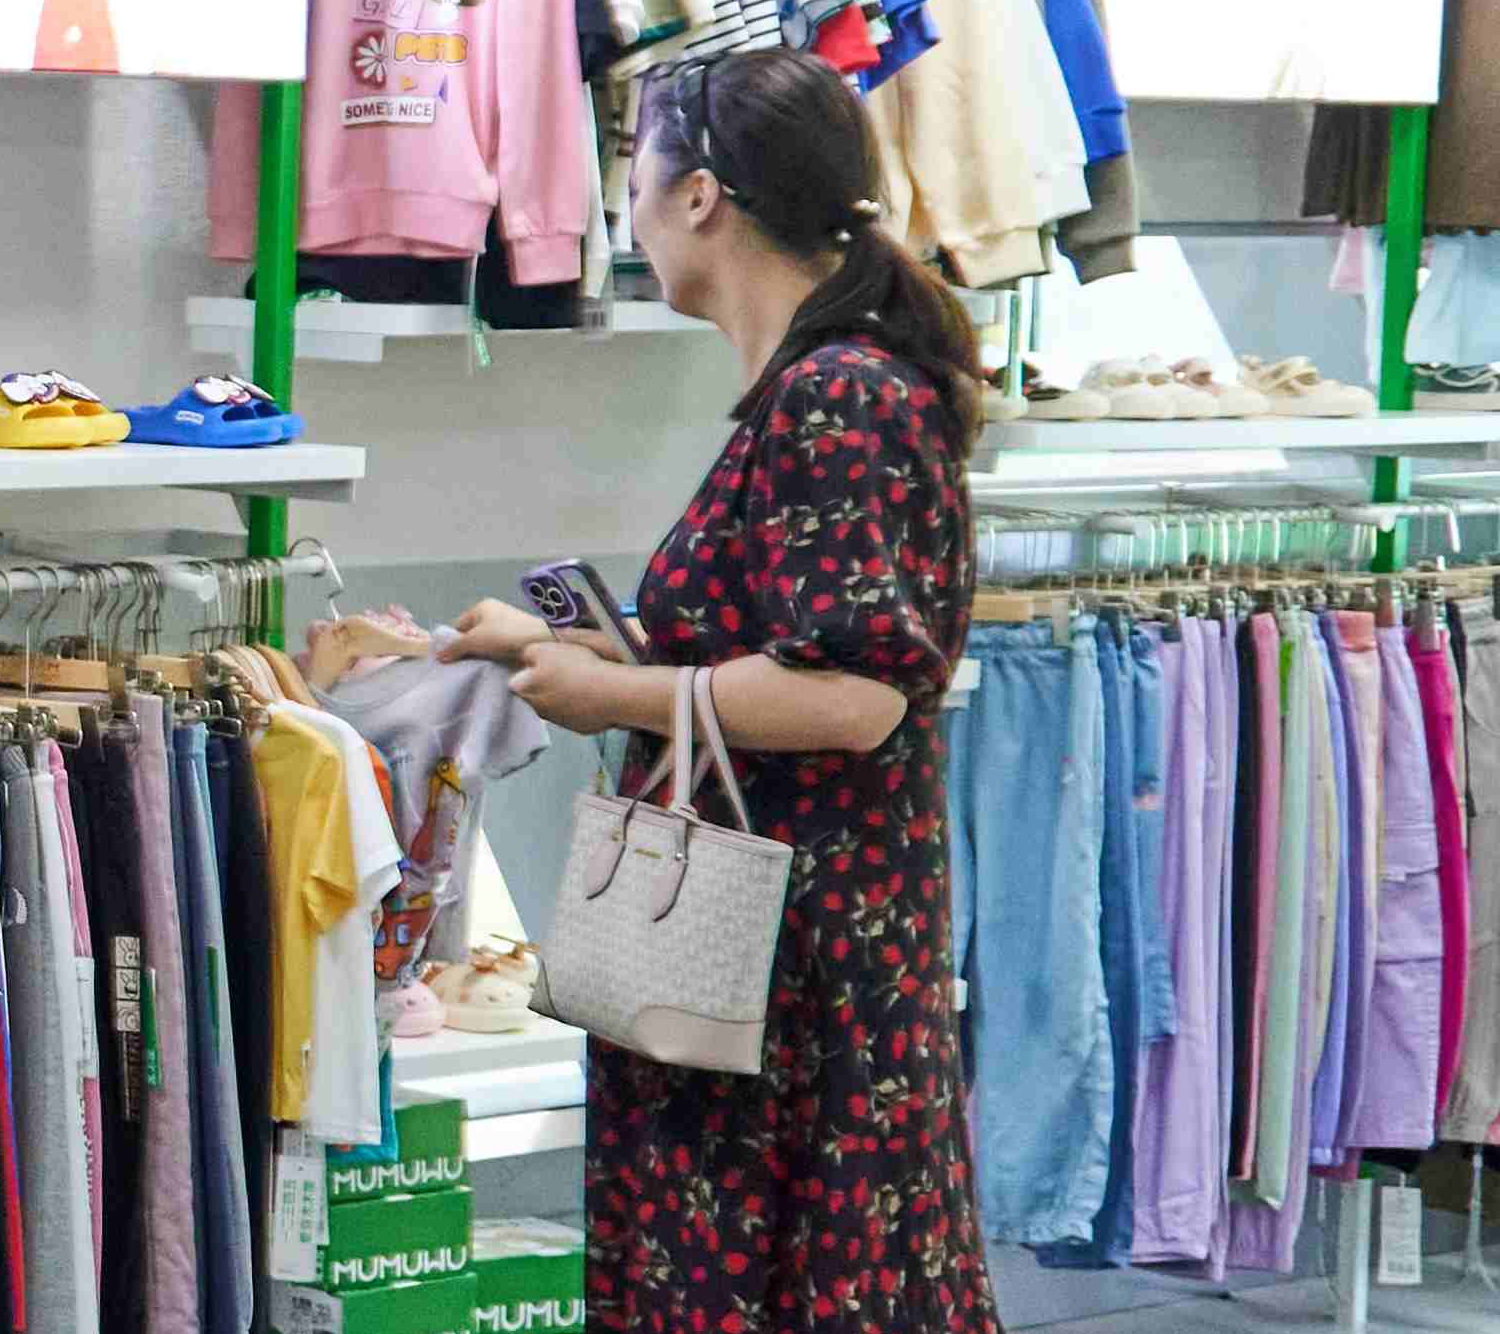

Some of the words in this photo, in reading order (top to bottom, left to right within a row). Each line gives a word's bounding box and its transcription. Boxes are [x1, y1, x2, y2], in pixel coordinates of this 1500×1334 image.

[332, 1156, 465, 1195] MUMUWU
[332, 1246, 468, 1285] MUMUWU
[474, 1298, 586, 1333] MUMU
